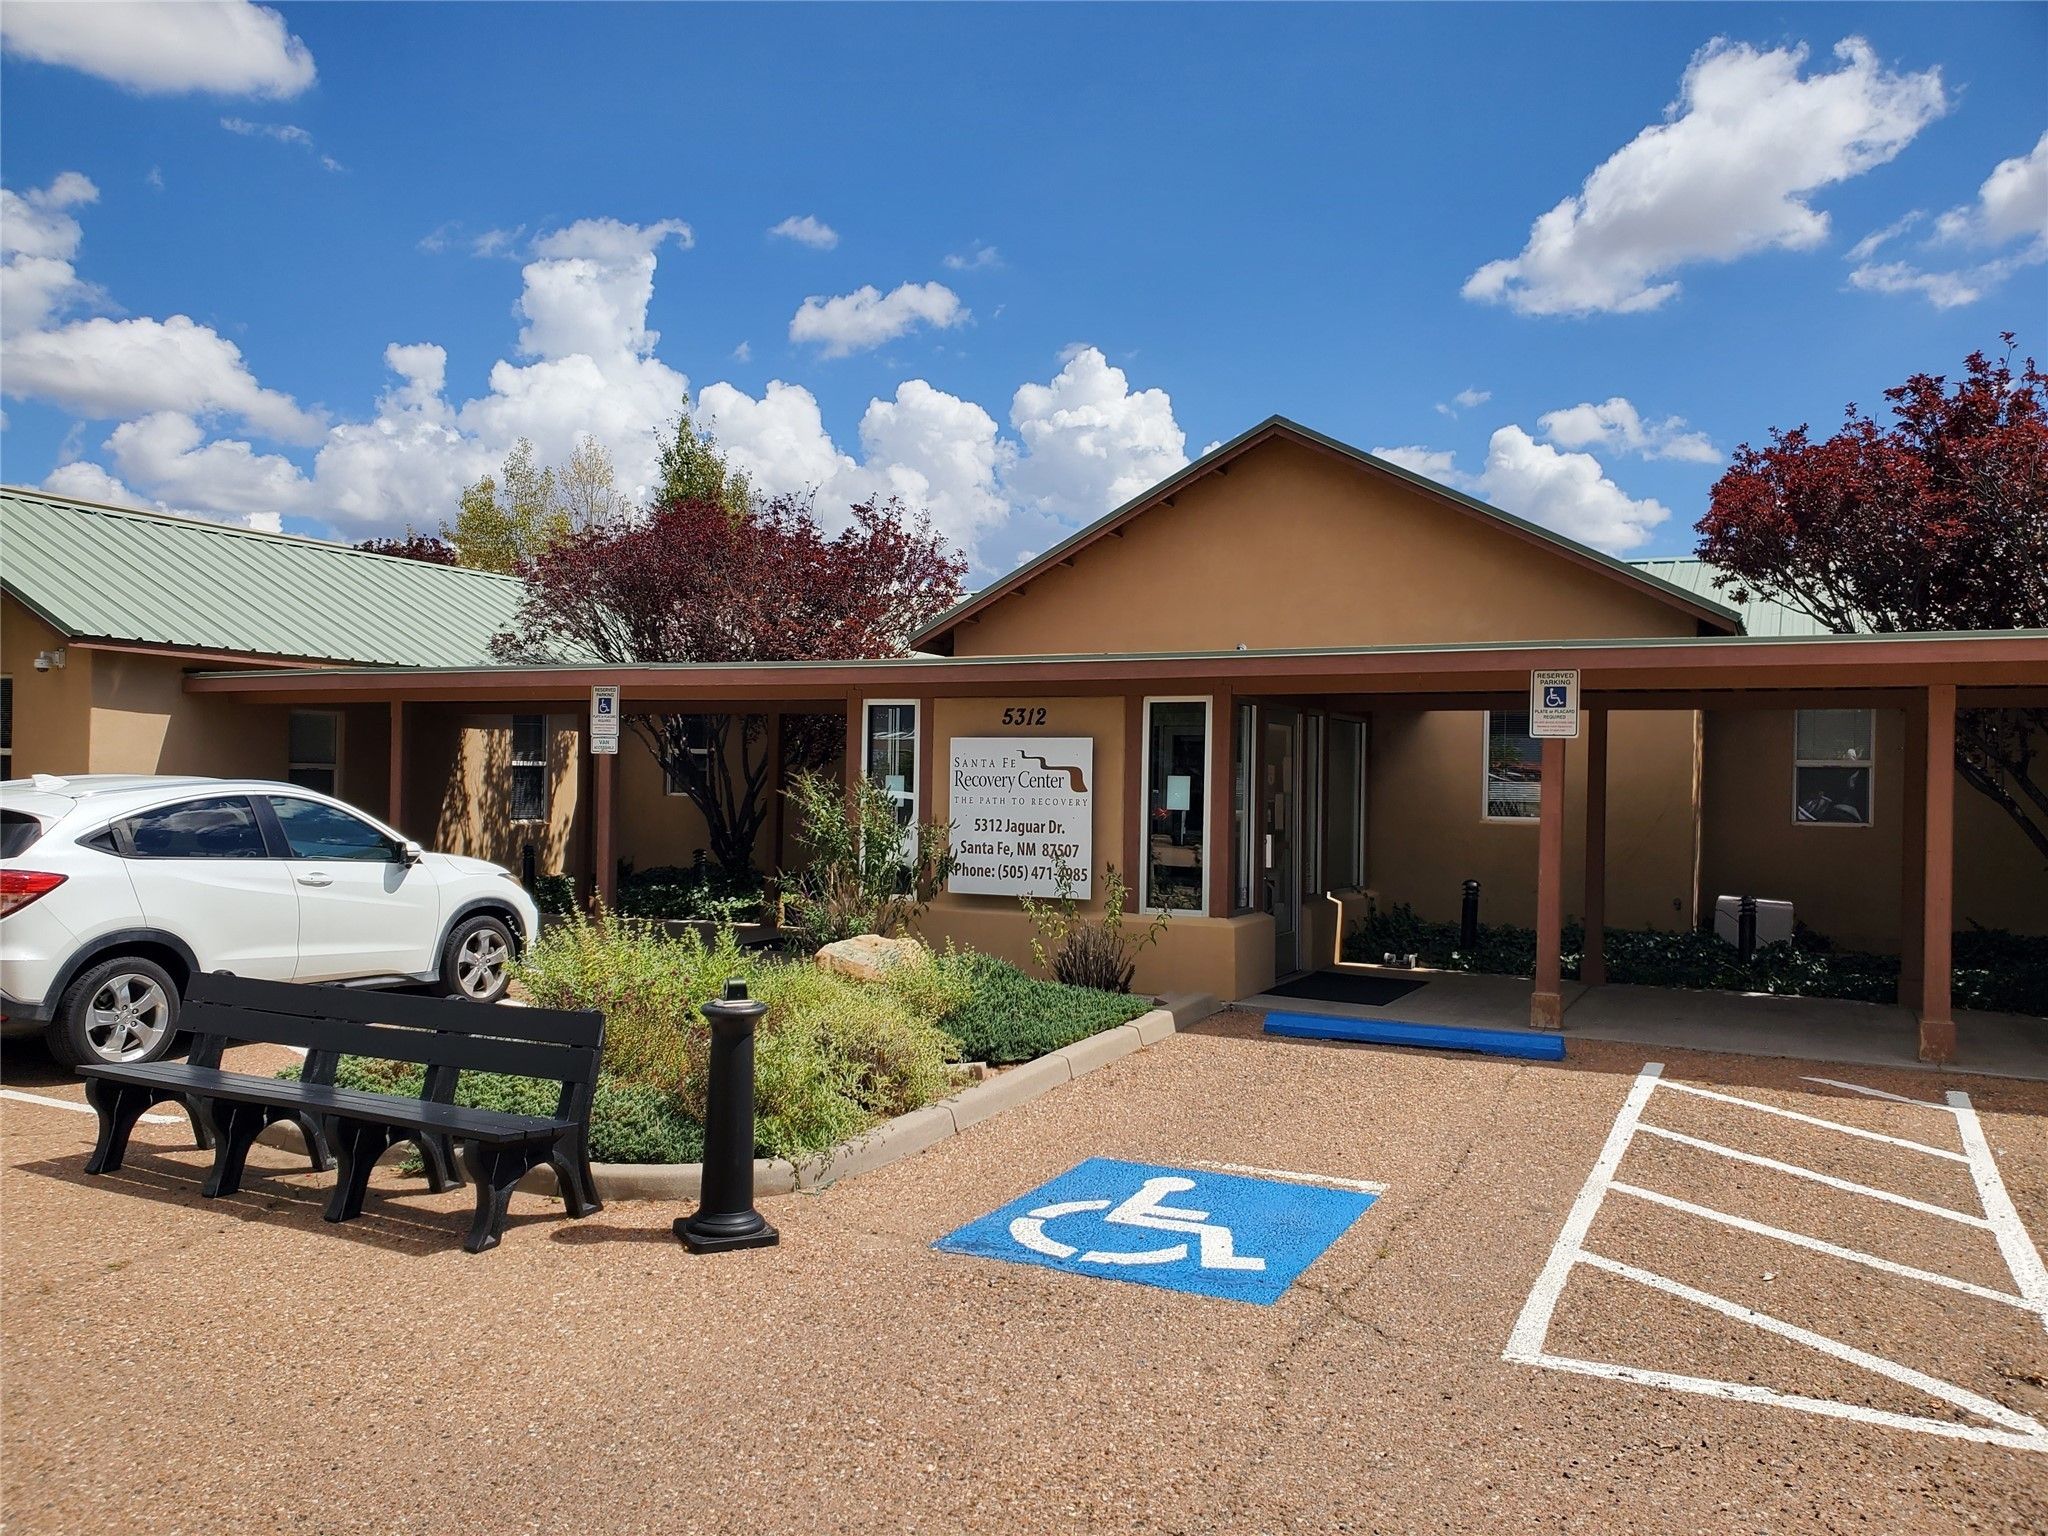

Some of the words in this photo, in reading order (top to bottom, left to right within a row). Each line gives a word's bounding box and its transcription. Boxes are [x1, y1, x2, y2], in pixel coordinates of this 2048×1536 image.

[1002, 707, 1047, 726] 5312
[954, 770, 1016, 793] Recovery
[1018, 770, 1065, 789] Center
[954, 796, 974, 804] THE
[979, 796, 1006, 805] PATH
[1012, 797, 1025, 805] TO
[1031, 798, 1088, 807] RECOVERY
[974, 818, 1002, 832] 5312
[1005, 818, 1046, 836] Jaguar
[1048, 820, 1065, 834] Dr.
[960, 840, 994, 855] Santa
[997, 841, 1014, 858] Fe,
[1017, 842, 1037, 856] NM
[1042, 843, 1080, 858] 87507
[954, 862, 995, 877] Phone:
[998, 864, 1029, 881] (505)
